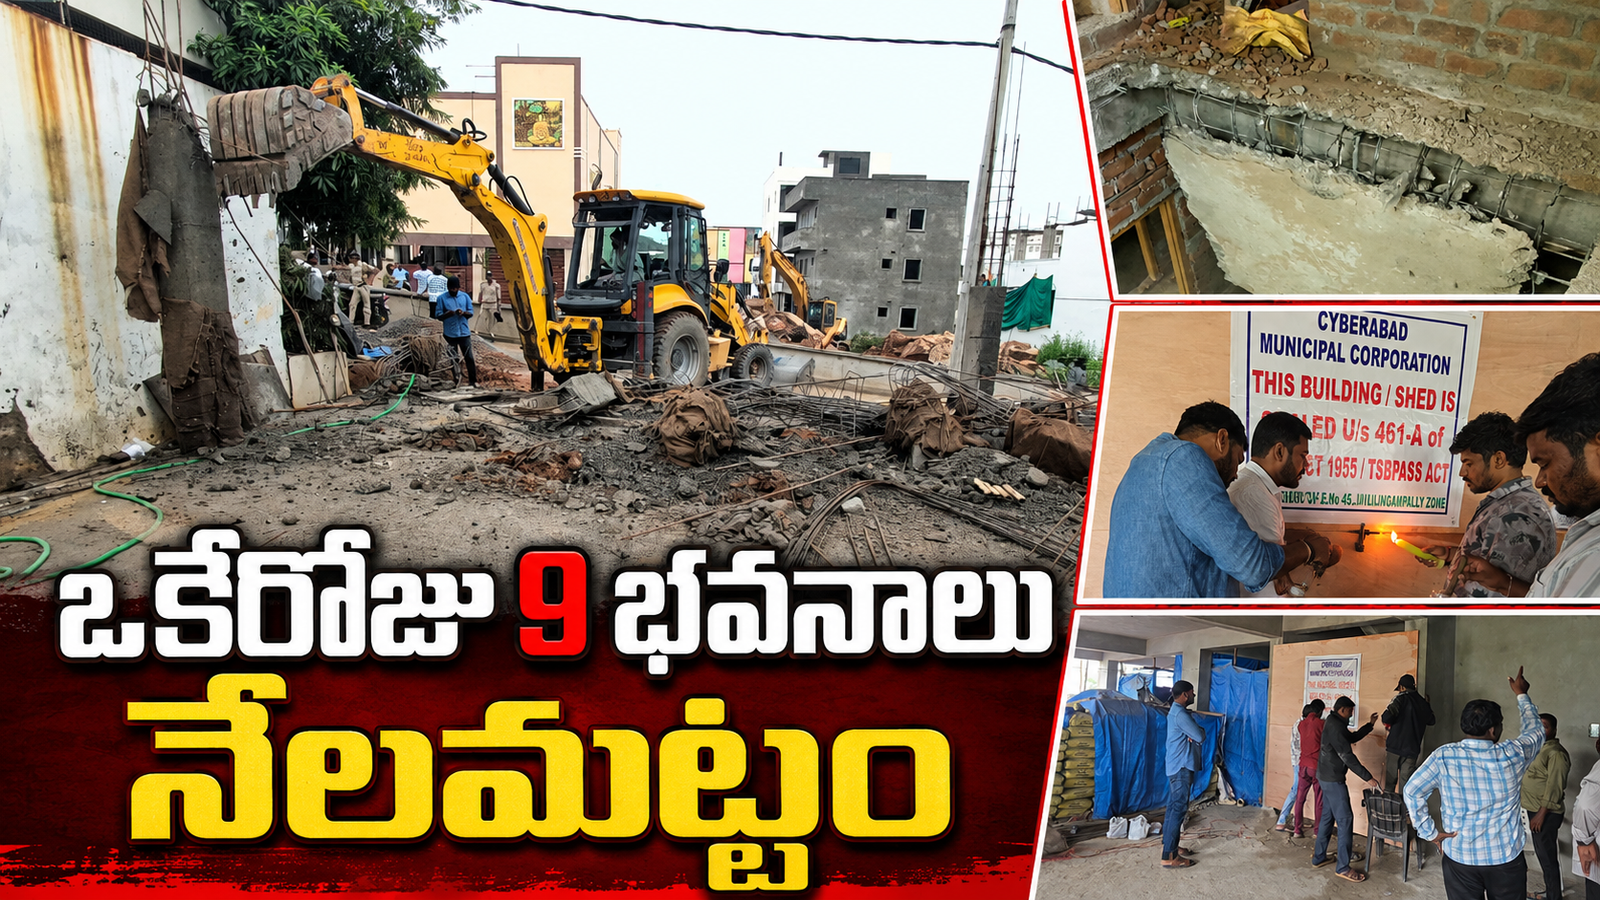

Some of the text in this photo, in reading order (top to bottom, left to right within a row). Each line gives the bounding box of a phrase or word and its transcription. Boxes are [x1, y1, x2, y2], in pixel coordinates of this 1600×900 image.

[1318, 311, 1408, 341] CYBERABAD
[1260, 332, 1451, 375] MUNICIPAL CORPORATION
[1252, 369, 1456, 412] THIS BUILDING / SHED IS
[1342, 418, 1370, 442] U/s
[1375, 421, 1422, 446] 461-A
[1428, 426, 1445, 448] of
[1328, 455, 1357, 479] 1955
[1360, 458, 1365, 479] /
[1368, 458, 1422, 482] TSBPASS
[1424, 462, 1449, 483] ACT
[1425, 496, 1446, 509] ZONE
